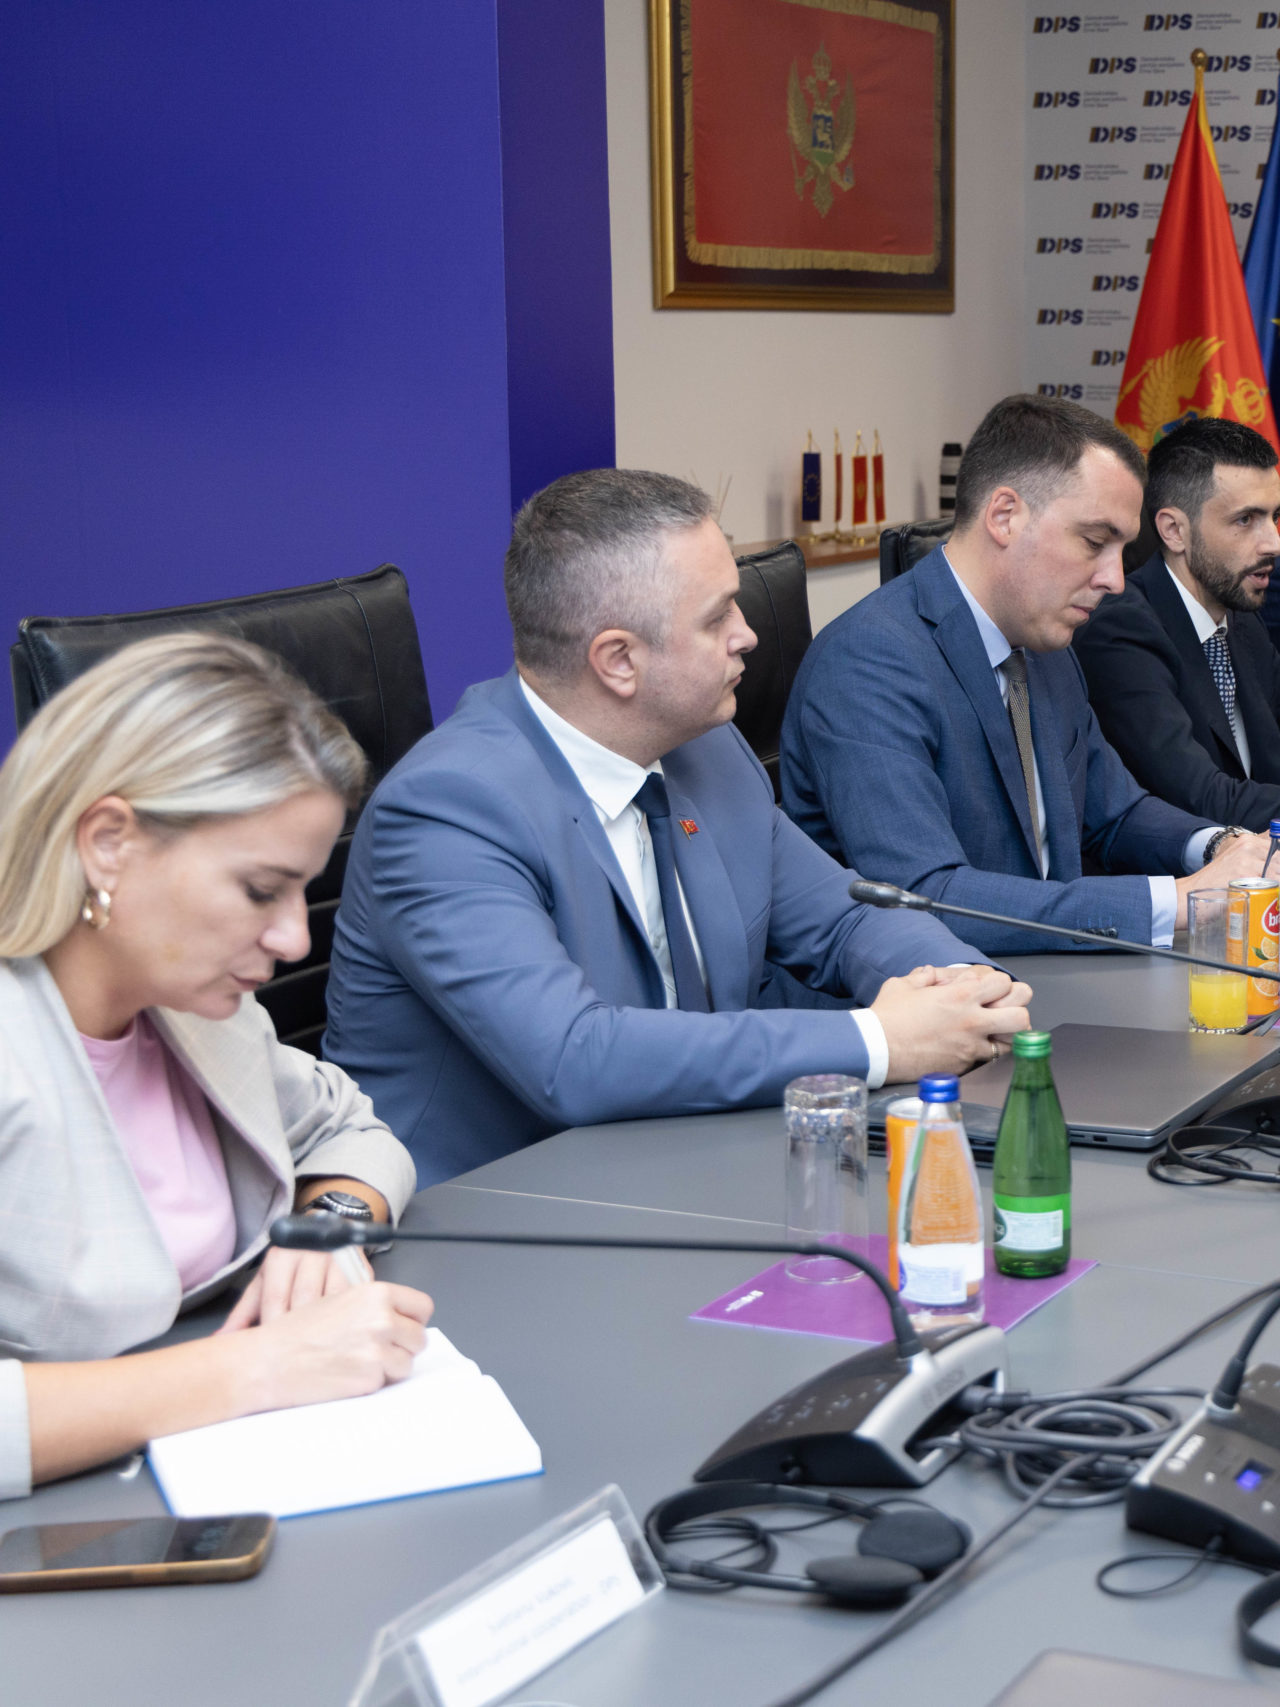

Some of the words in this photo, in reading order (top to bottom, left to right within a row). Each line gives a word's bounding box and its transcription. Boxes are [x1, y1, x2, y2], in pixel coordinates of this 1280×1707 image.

[1033, 16, 1080, 33] DPS
[1144, 14, 1192, 31] DPS
[1089, 57, 1136, 74] DPS
[1033, 91, 1080, 108] DPS
[1090, 126, 1137, 143] DPS
[1034, 164, 1081, 180] DPS
[1092, 202, 1139, 218] DPS
[1228, 202, 1253, 218] PS
[1037, 238, 1083, 253] DPS
[1092, 276, 1139, 291] DPS
[1037, 309, 1083, 325] DPS
[1092, 350, 1126, 366] DP
